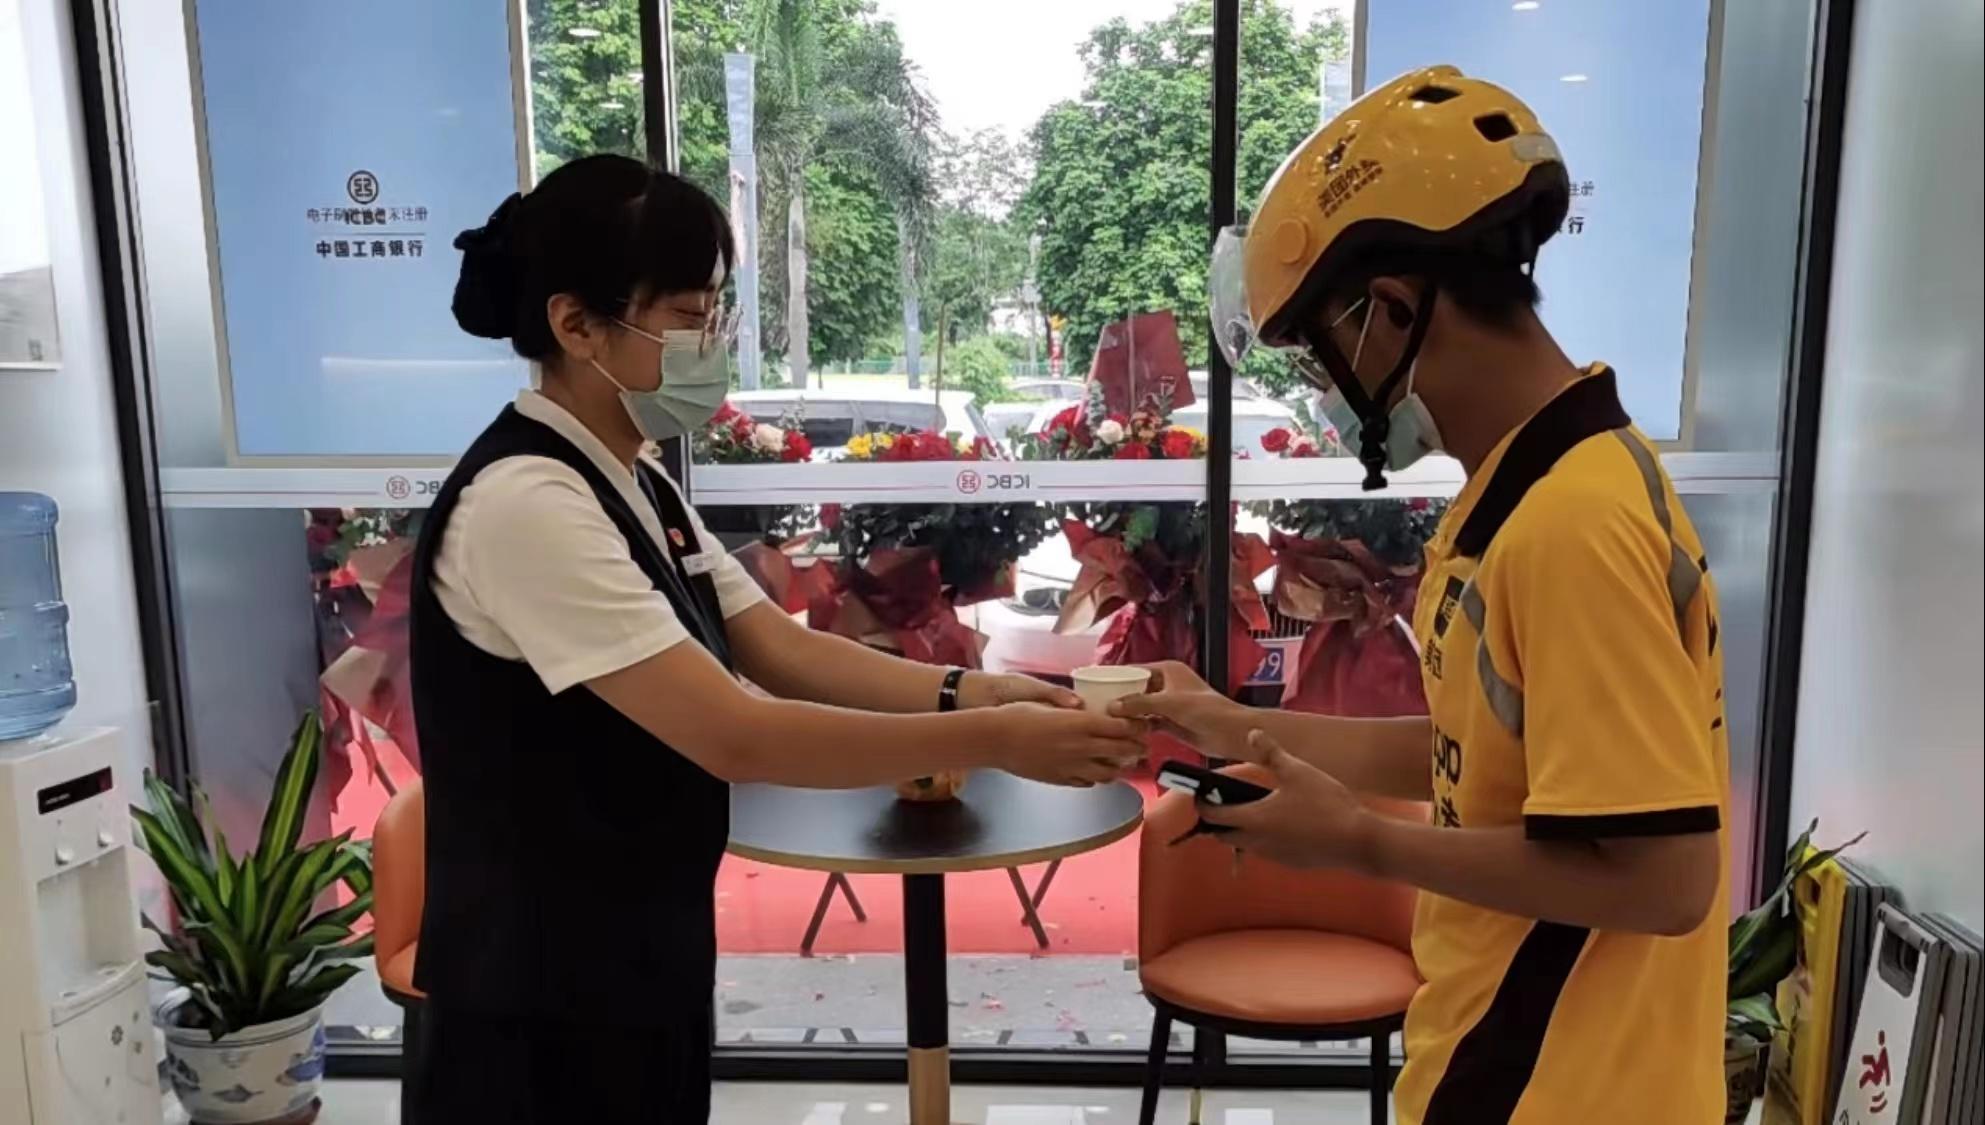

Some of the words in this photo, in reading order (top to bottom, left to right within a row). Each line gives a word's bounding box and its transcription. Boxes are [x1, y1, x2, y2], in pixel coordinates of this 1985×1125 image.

[315, 239, 424, 259] 中国工商银行
